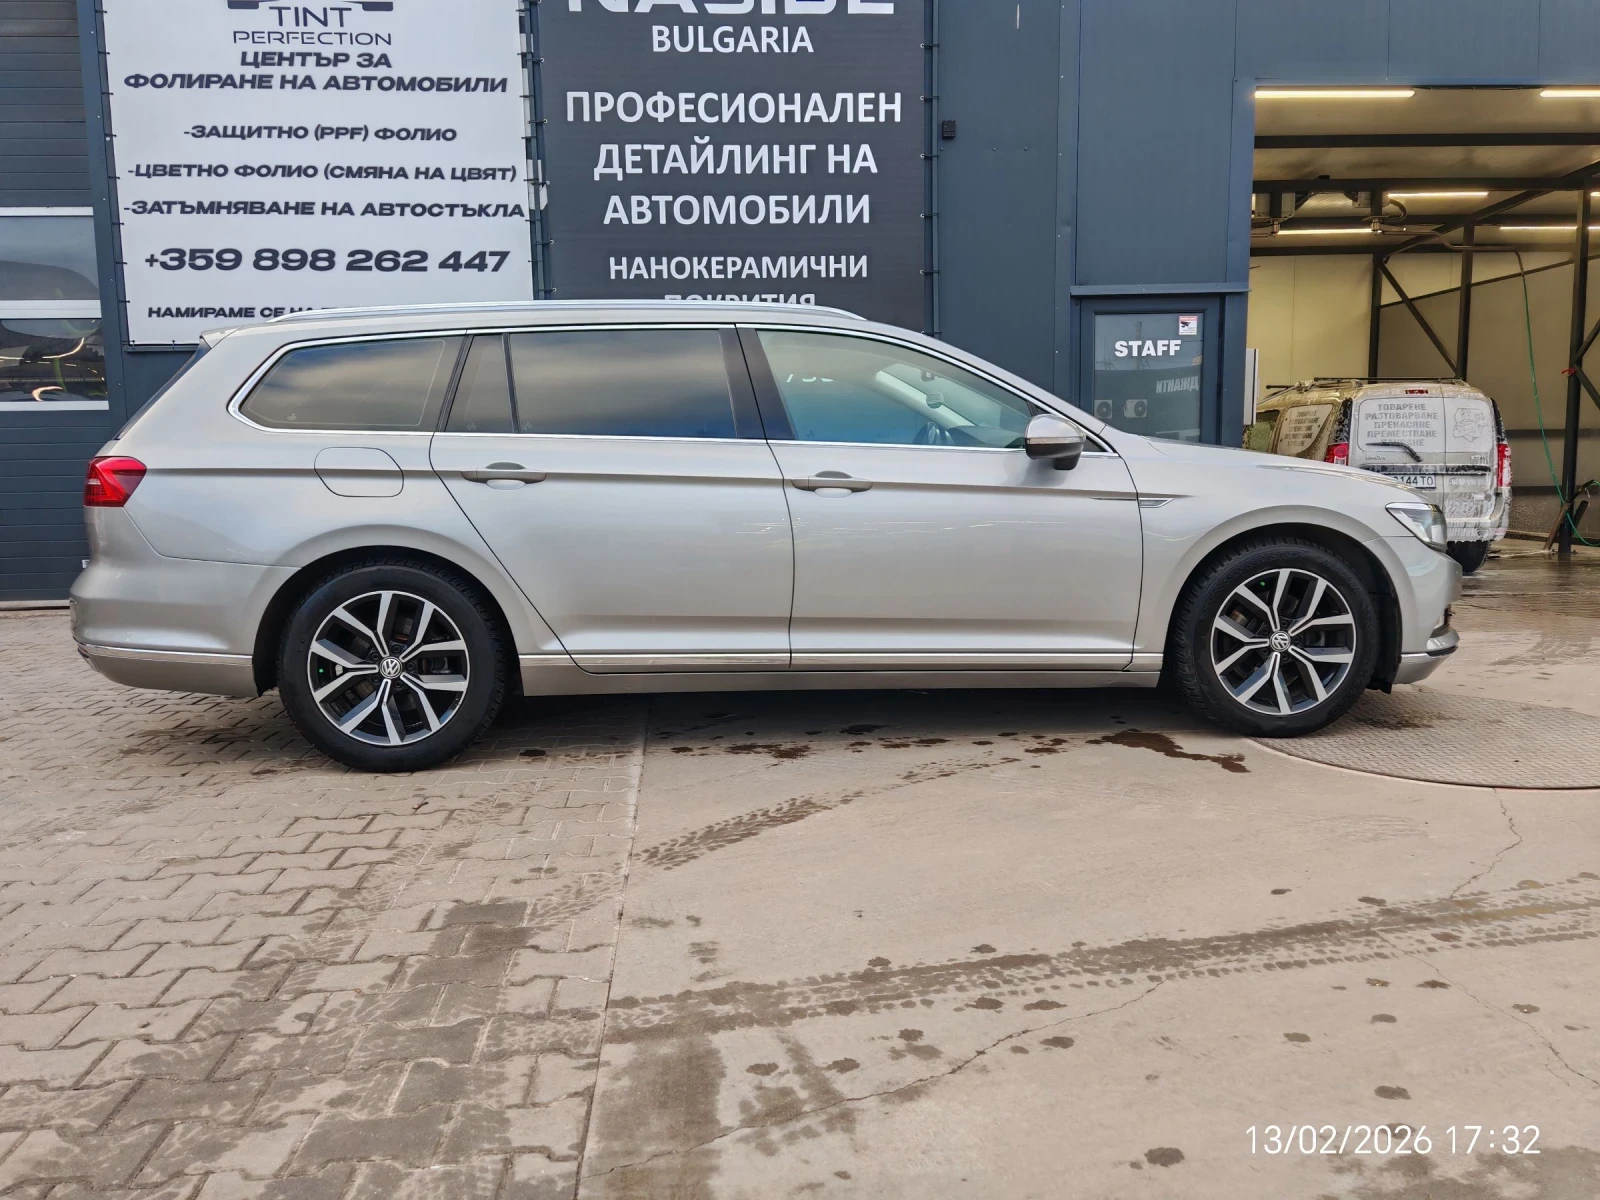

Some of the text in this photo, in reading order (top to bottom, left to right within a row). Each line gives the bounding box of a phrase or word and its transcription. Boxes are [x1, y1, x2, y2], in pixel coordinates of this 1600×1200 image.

[269, 6, 352, 28] TINT
[232, 31, 392, 46] PERFECTION
[651, 25, 815, 53] BULGARIA
[240, 51, 392, 69] ЦЕНТЪР ЗА
[123, 73, 508, 93] ФОЛИРАНЕ НА АВТОМОБИЛИ
[566, 91, 902, 123] ПРОФЕСИОНАЛЕН
[183, 124, 457, 142] -ЗАЩИТНО (PPF) ФОЛИО
[594, 136, 878, 181] ДЕТАЙЛИНГ НА
[128, 163, 517, 184] -ЦВЕТНО ФОЛИО (СМЯНА НА ЦВЯТ)
[123, 200, 526, 219] -ЗАТЪМНЯВАНЕ НА АВТОСТЪКЛА
[603, 194, 870, 225] АВТОМОБИЛИ
[145, 247, 511, 273] +359 898 262 447
[609, 255, 868, 279] НАНОКЕРАМИЧНИ
[148, 306, 256, 318] НАМИРАМЕ
[259, 306, 286, 318] СЕ
[1114, 340, 1182, 357] STAFF
[1377, 403, 1427, 411] ТОВАРЕНЕ
[1393, 475, 1418, 486] 144
